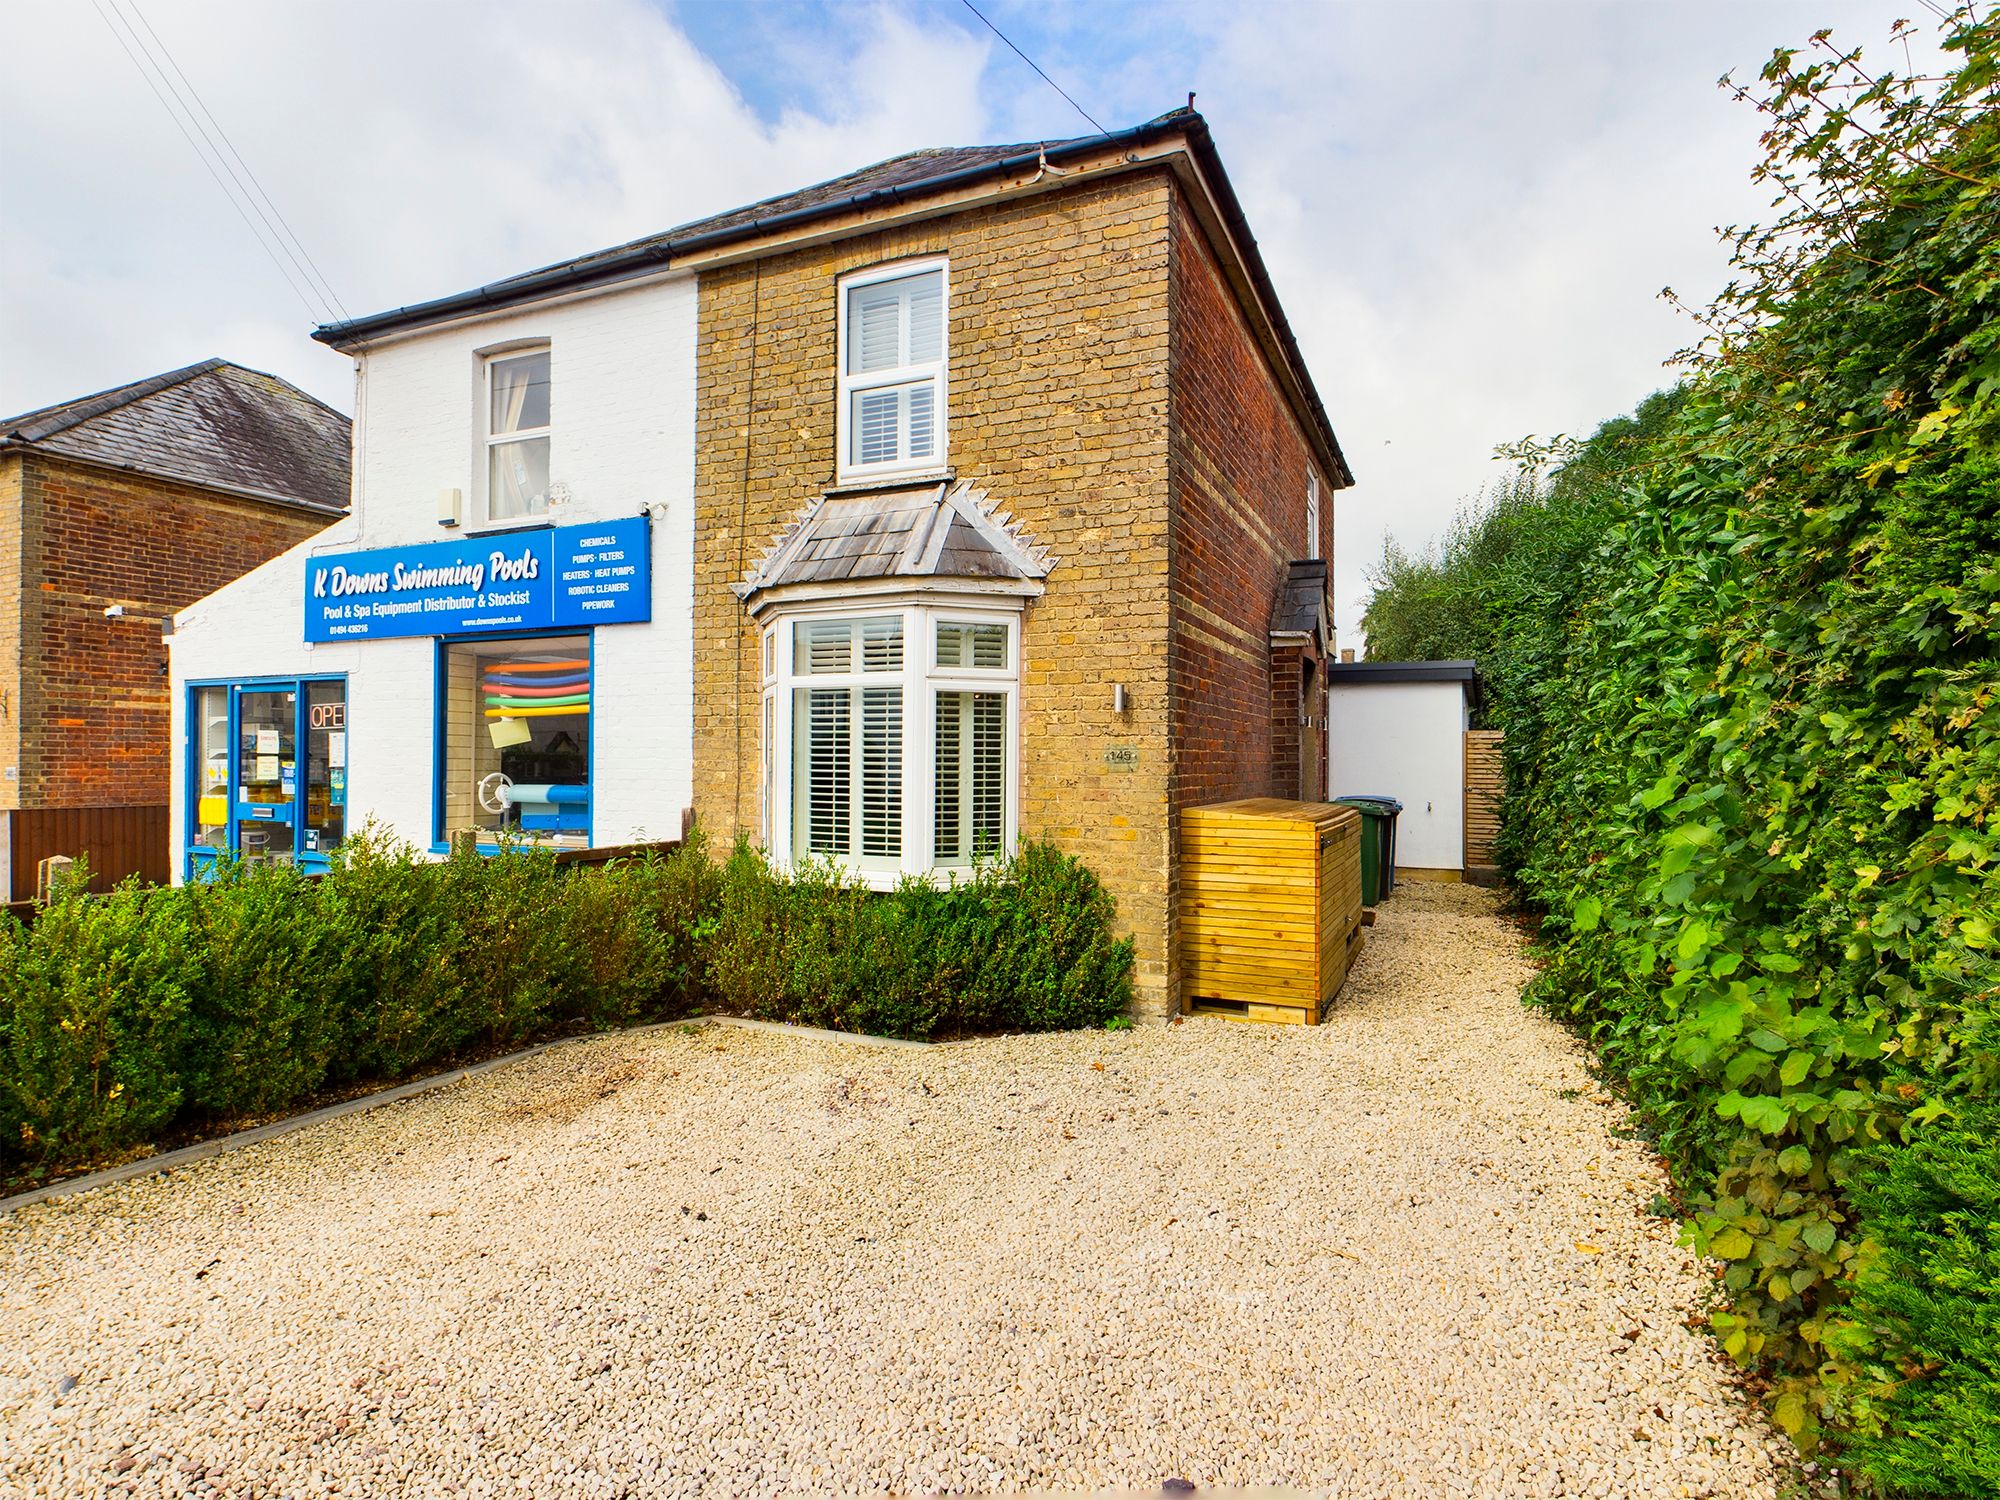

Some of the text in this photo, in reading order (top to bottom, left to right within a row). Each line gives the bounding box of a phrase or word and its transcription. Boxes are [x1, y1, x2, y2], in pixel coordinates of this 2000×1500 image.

[580, 536, 616, 548] CHEMICALS
[599, 551, 624, 562] FILTERS
[313, 548, 539, 598] K Downs Swimming Pools
[594, 567, 611, 578] HEAT
[612, 566, 635, 577] PUMPS
[568, 582, 629, 596] ROBOTIC CLEANERS
[323, 590, 530, 620] Pool & Spa Equipment Distributor & Stockist
[582, 600, 615, 610] PIPEWORK
[312, 705, 346, 727] OPE
[1109, 751, 1131, 761] 145
